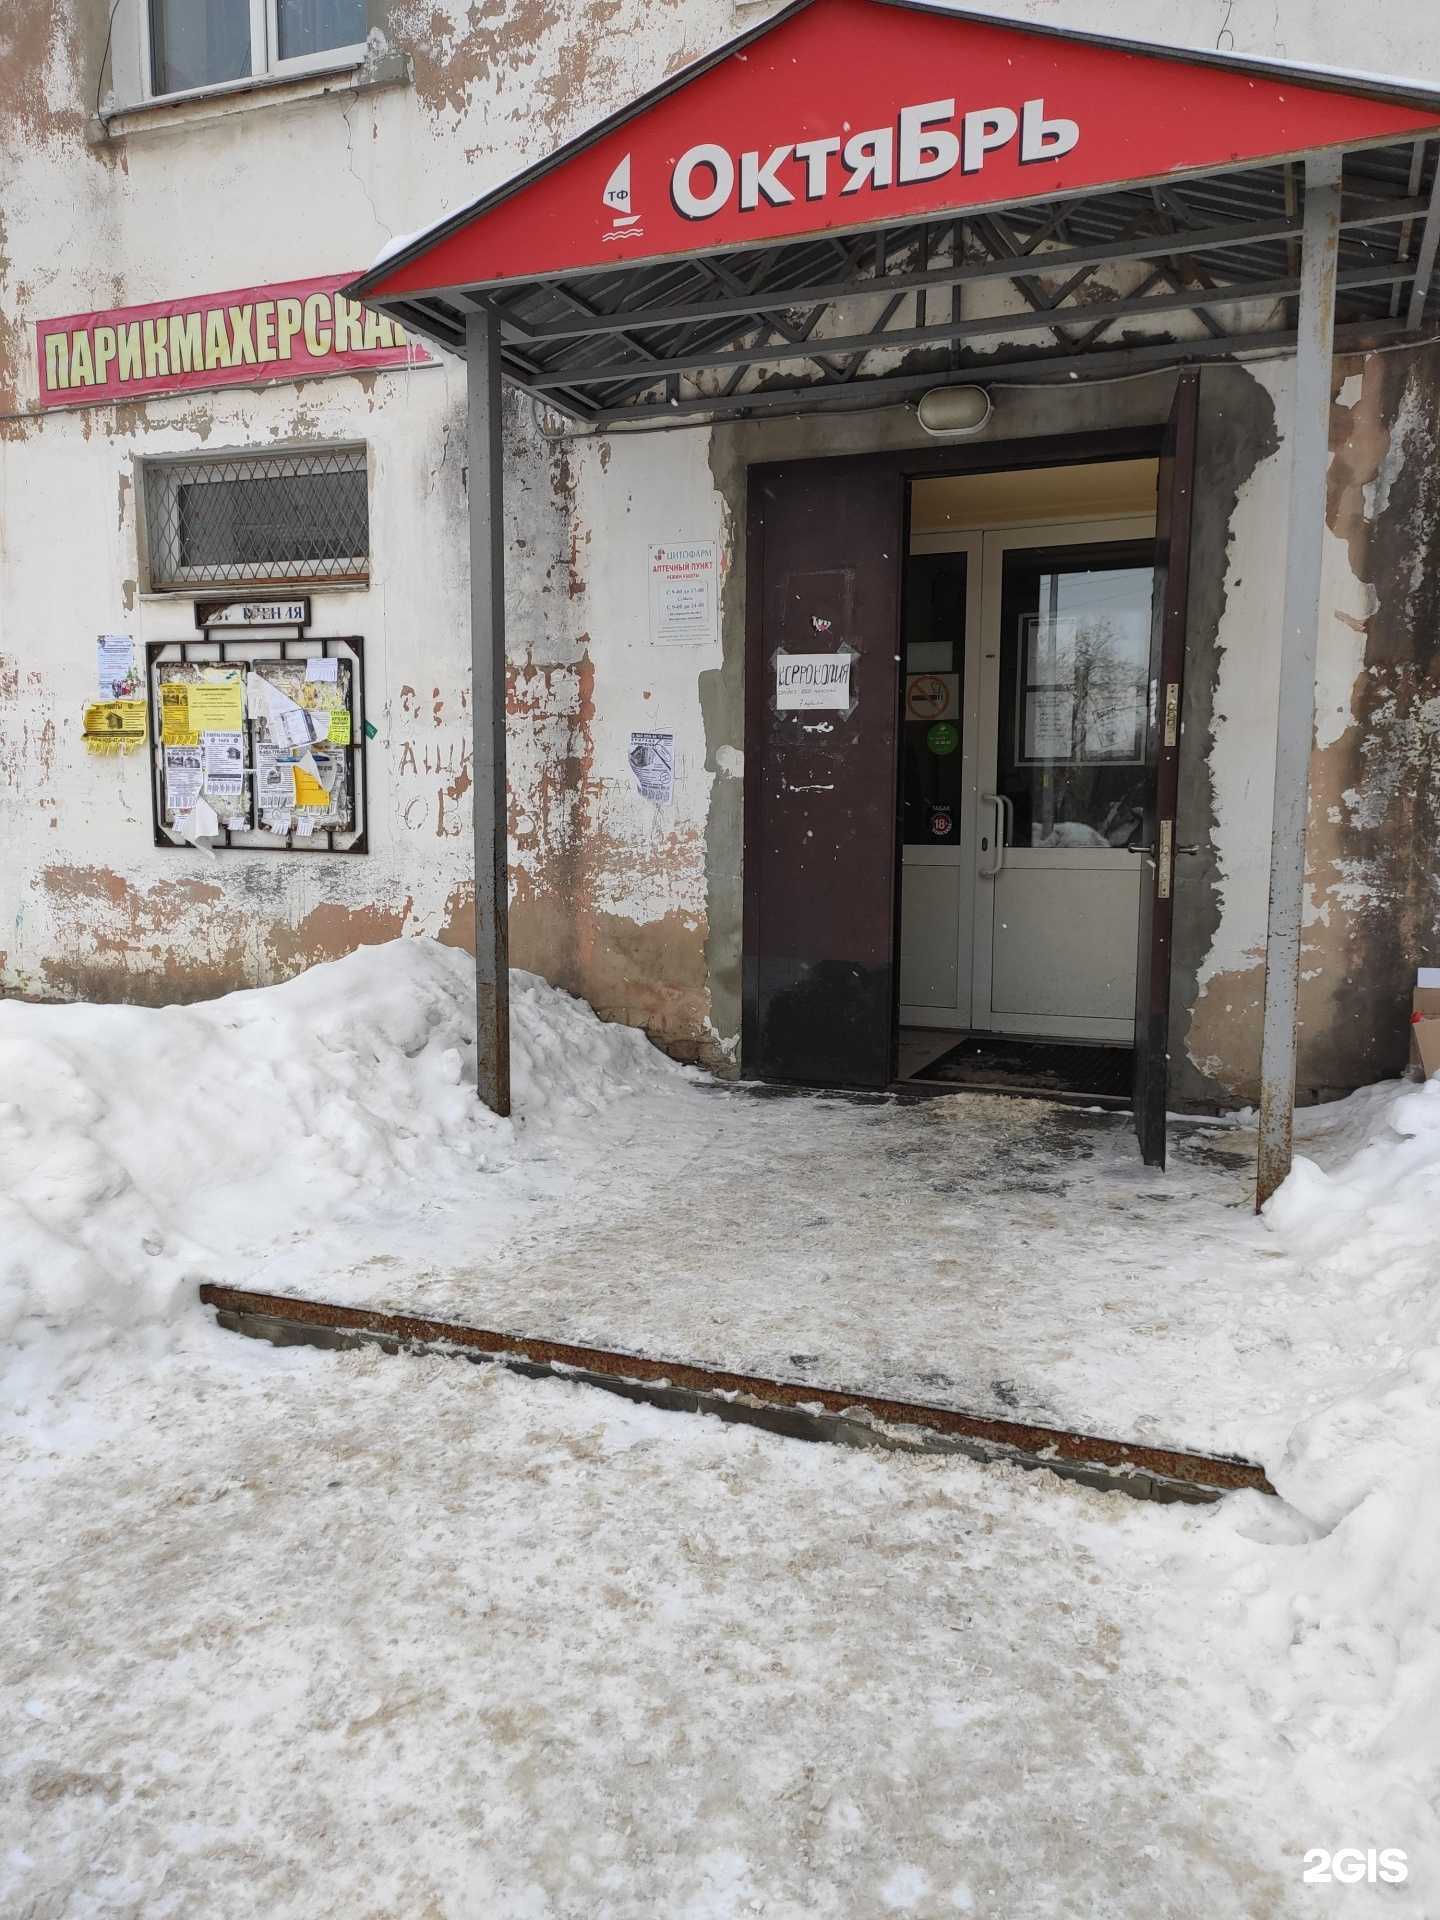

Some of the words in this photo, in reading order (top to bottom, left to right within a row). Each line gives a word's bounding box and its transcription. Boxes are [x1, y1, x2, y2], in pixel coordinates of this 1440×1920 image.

[608, 190, 629, 202] ТФ
[653, 563, 690, 573] АПТЕЧНЫЙ
[691, 561, 713, 571] ПУНКТ
